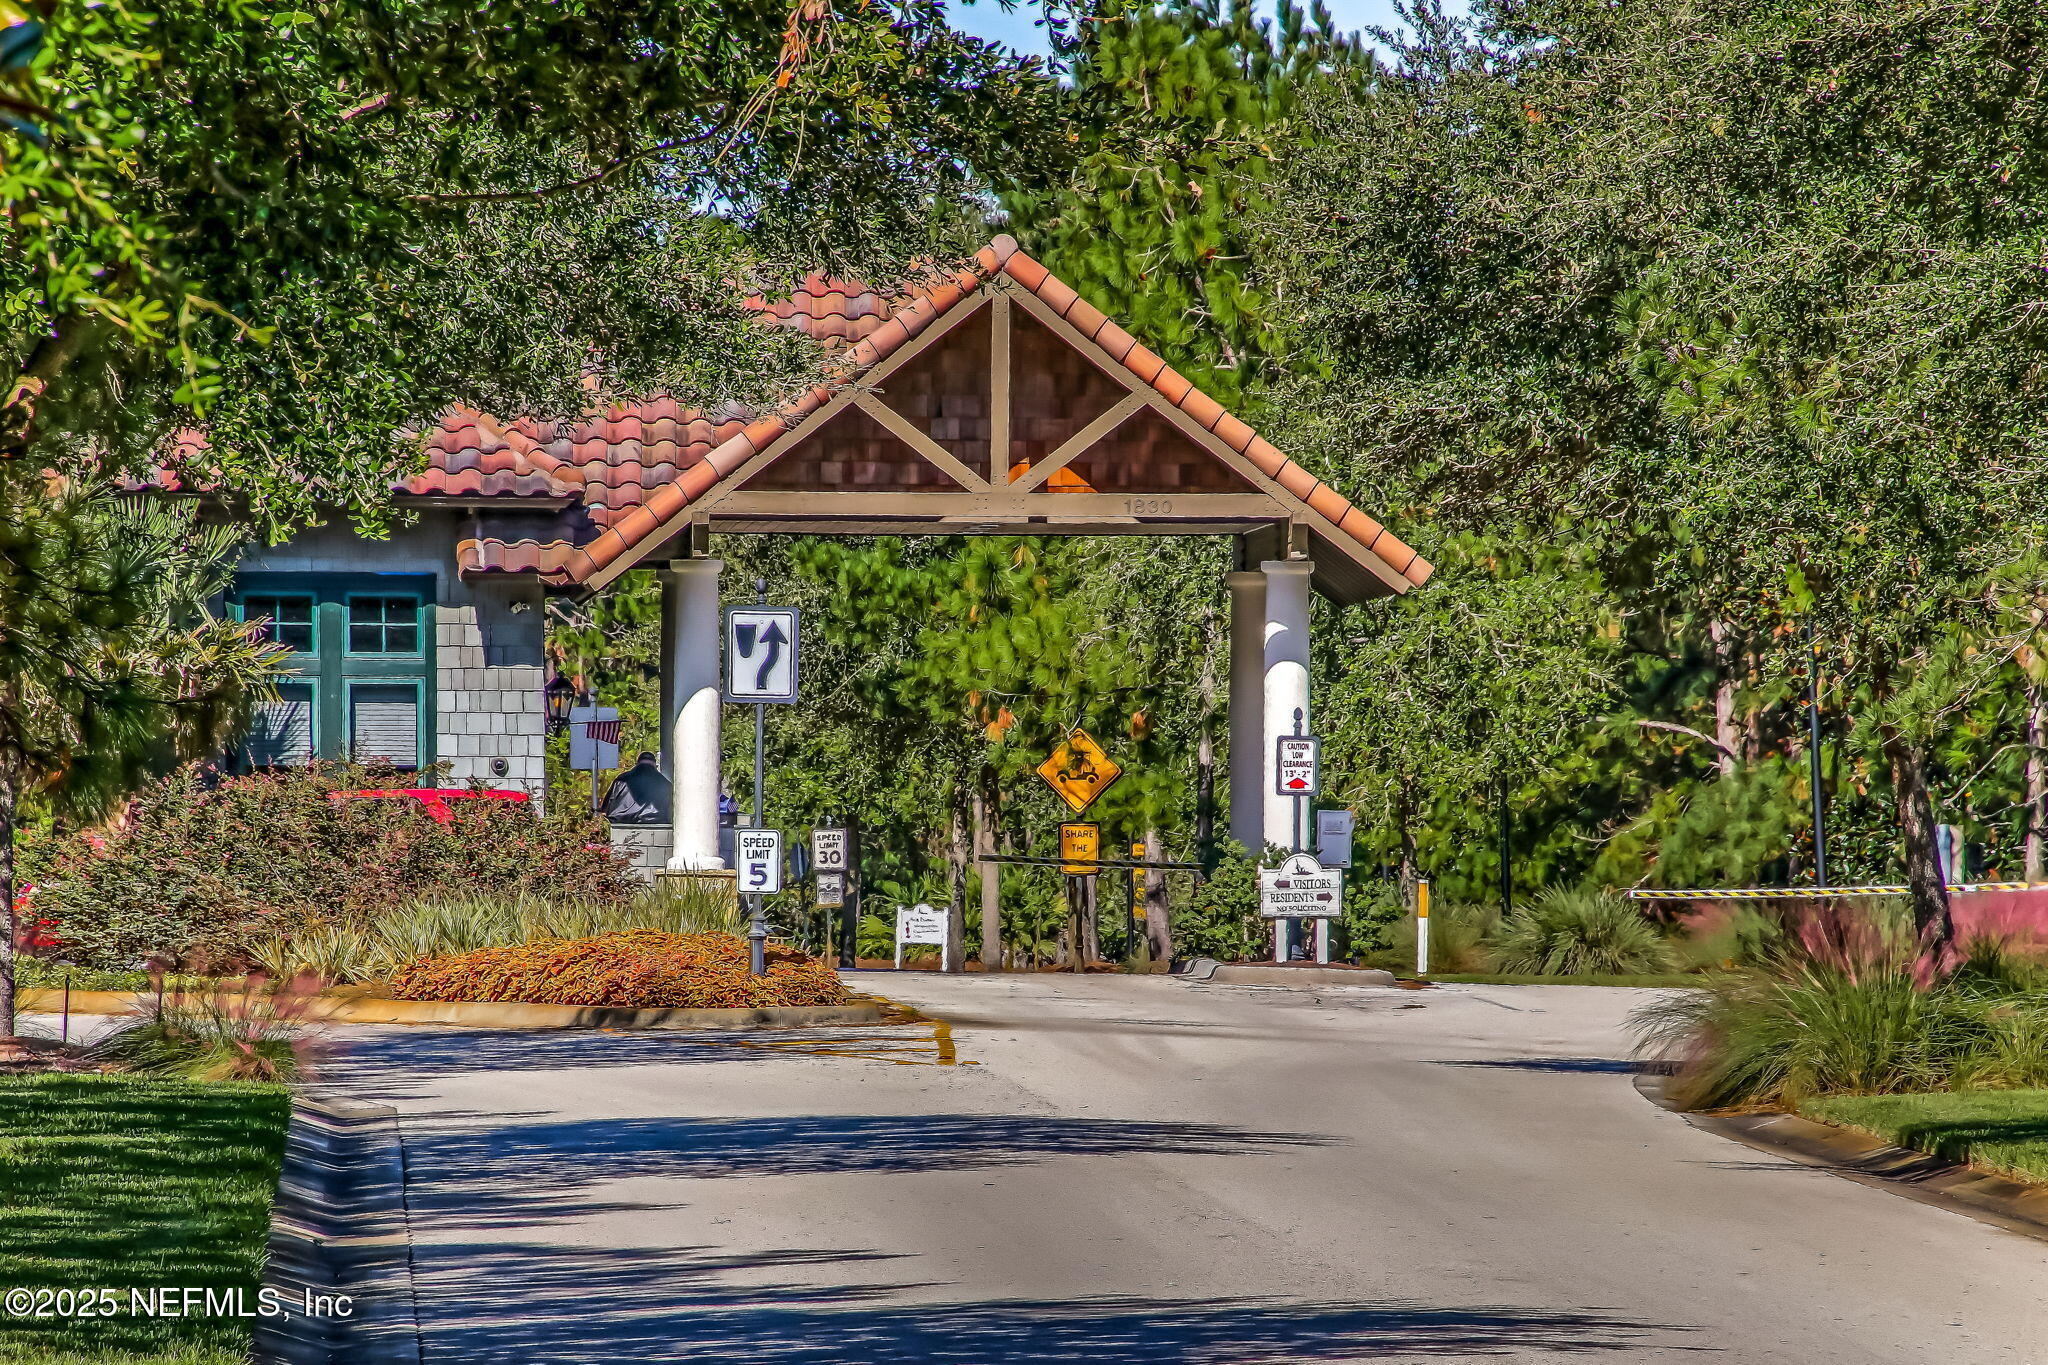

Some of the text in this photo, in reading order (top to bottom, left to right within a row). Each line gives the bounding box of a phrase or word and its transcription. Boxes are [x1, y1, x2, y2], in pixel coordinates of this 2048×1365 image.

[1124, 498, 1173, 515] 1830
[1287, 742, 1309, 750] CAUTION
[1065, 830, 1094, 838] SHARE
[743, 837, 775, 848] SPEED
[1071, 844, 1088, 852] THE
[746, 849, 770, 860] LIMIT
[819, 850, 841, 865] 30
[749, 862, 768, 887] 5
[1293, 879, 1331, 889] VISITORS
[1270, 893, 1315, 903] RESIDENTS
